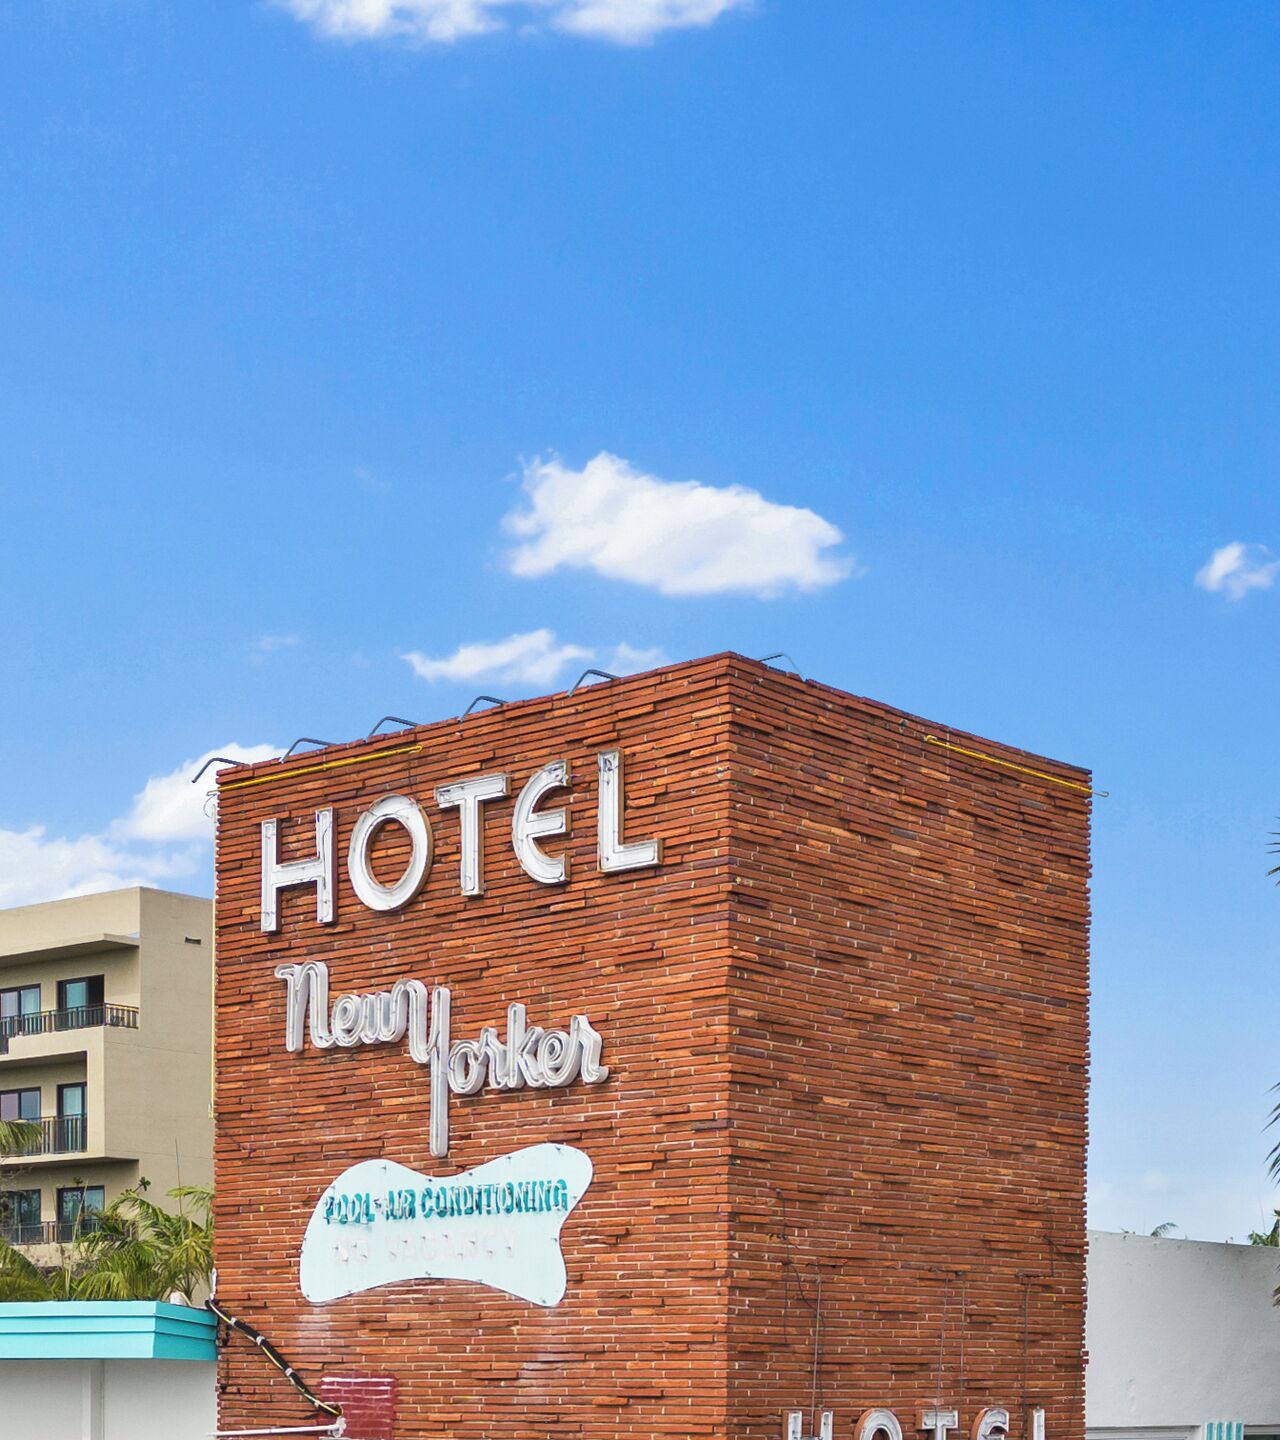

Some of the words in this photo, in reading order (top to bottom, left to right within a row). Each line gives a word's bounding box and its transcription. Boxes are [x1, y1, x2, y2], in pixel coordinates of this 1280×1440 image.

[261, 747, 663, 932] HOTEL
[274, 960, 410, 1053] New
[393, 978, 609, 1158] Yorker
[421, 1179, 568, 1218] CONDITIONING
